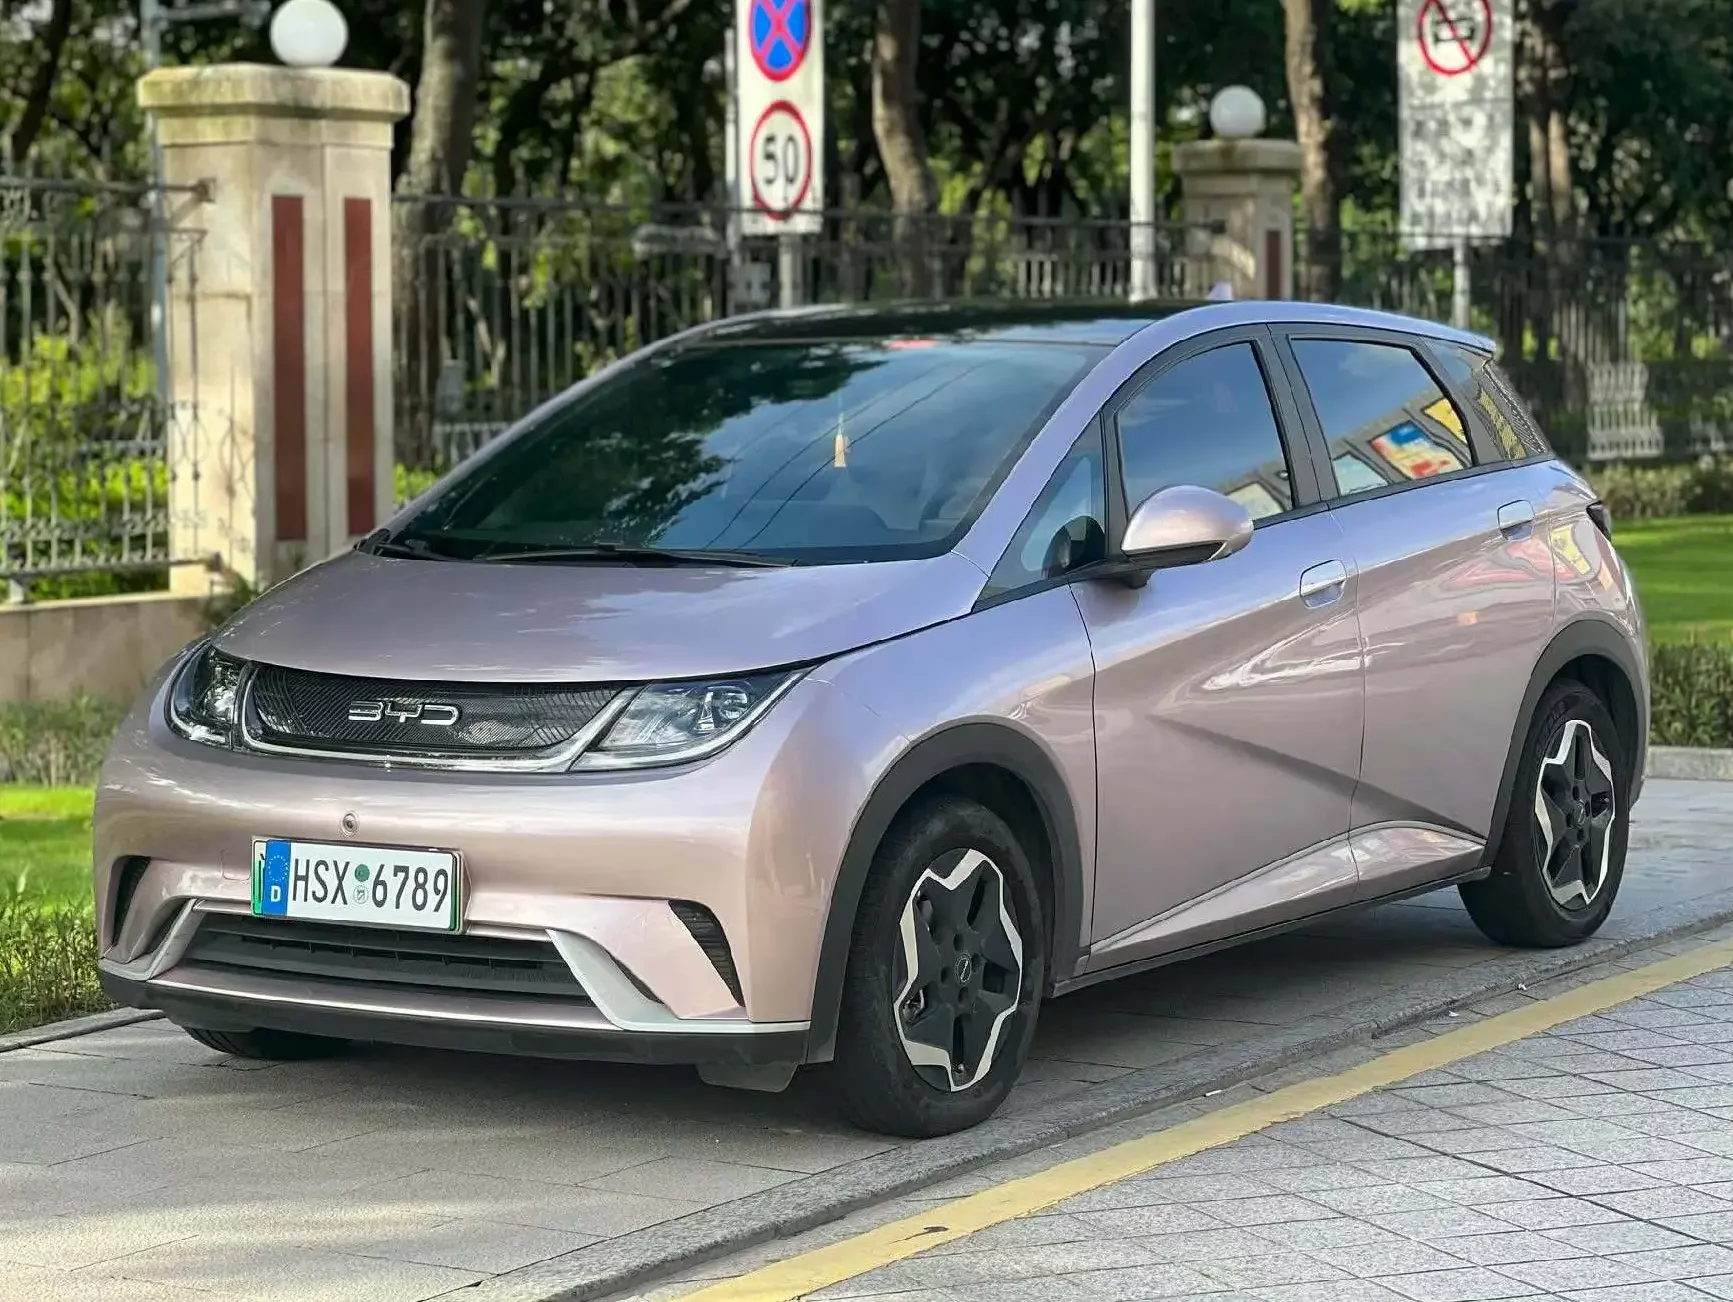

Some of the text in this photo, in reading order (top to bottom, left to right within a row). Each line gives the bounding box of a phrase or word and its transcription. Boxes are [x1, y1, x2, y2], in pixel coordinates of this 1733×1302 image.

[763, 133, 798, 185] 50
[348, 701, 459, 726] BYD
[270, 885, 281, 903] D
[292, 857, 449, 913] HSX 6789
